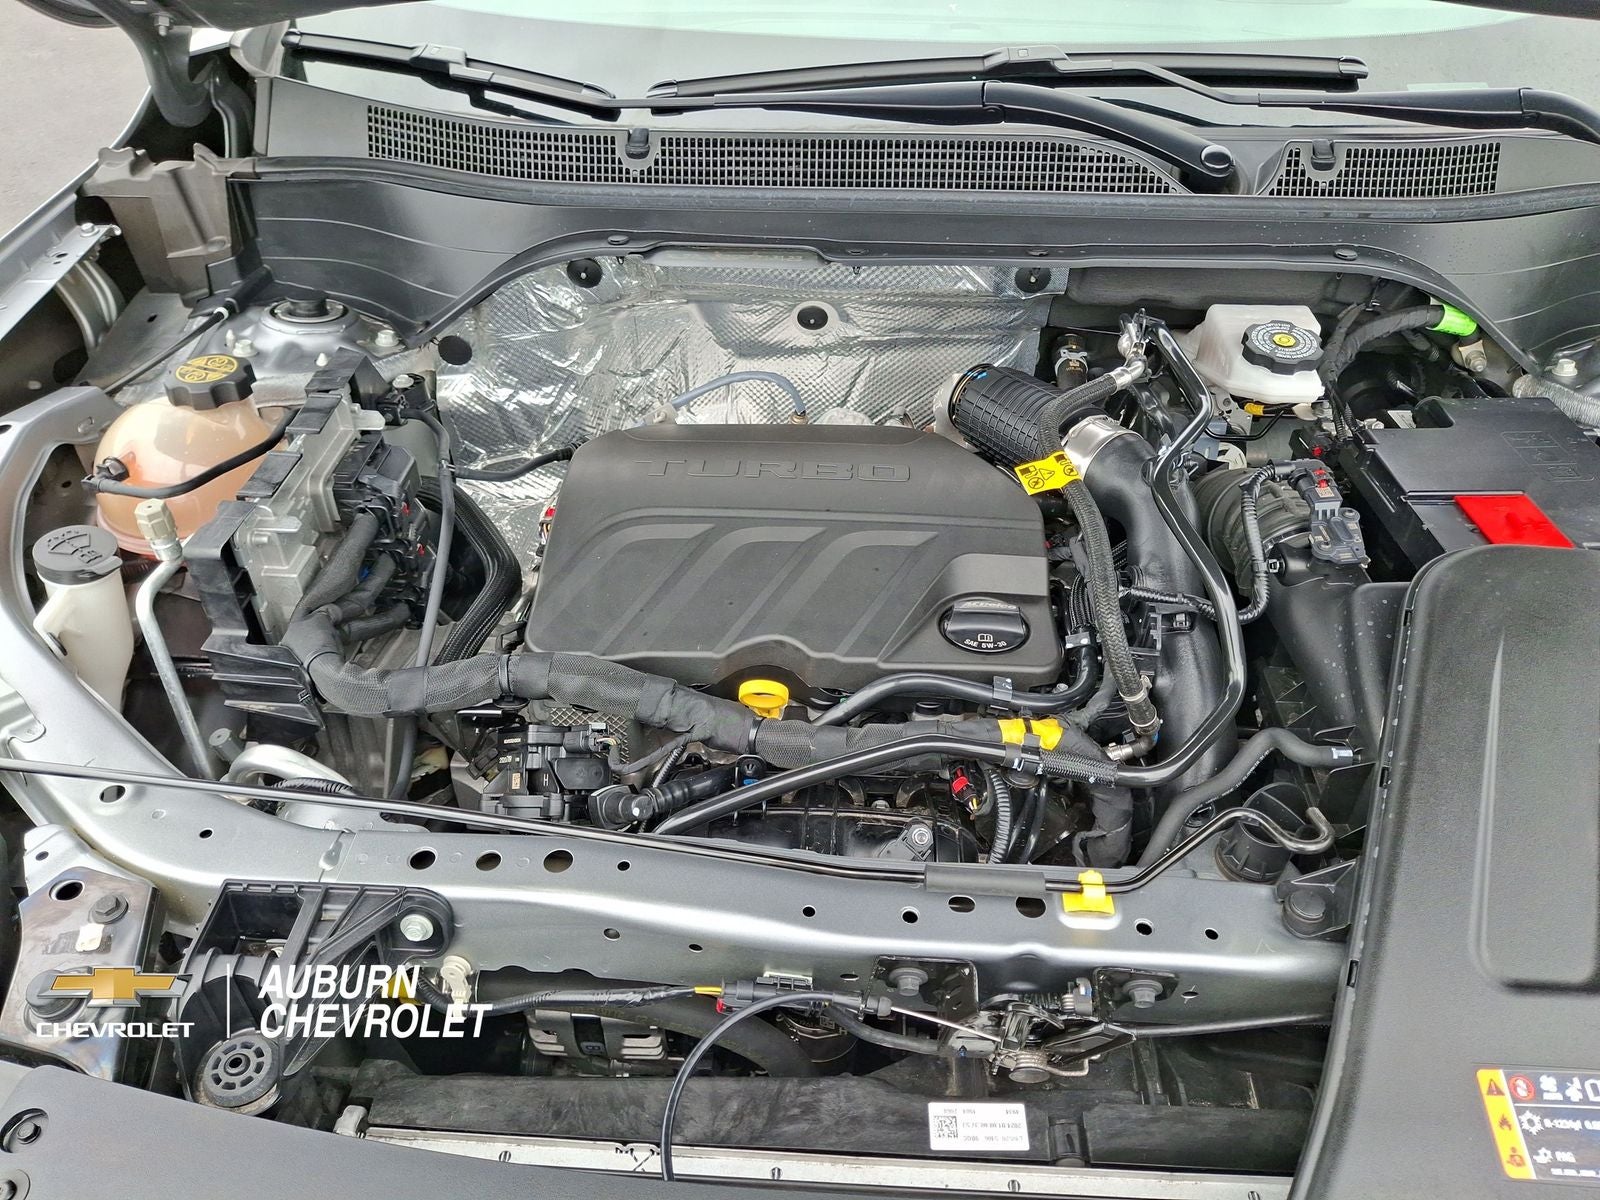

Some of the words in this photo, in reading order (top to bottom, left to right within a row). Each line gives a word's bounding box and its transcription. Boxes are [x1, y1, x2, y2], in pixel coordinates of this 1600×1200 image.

[634, 459, 911, 482] TURBO
[964, 638, 979, 648] SAE
[981, 640, 1007, 649] 5W-30
